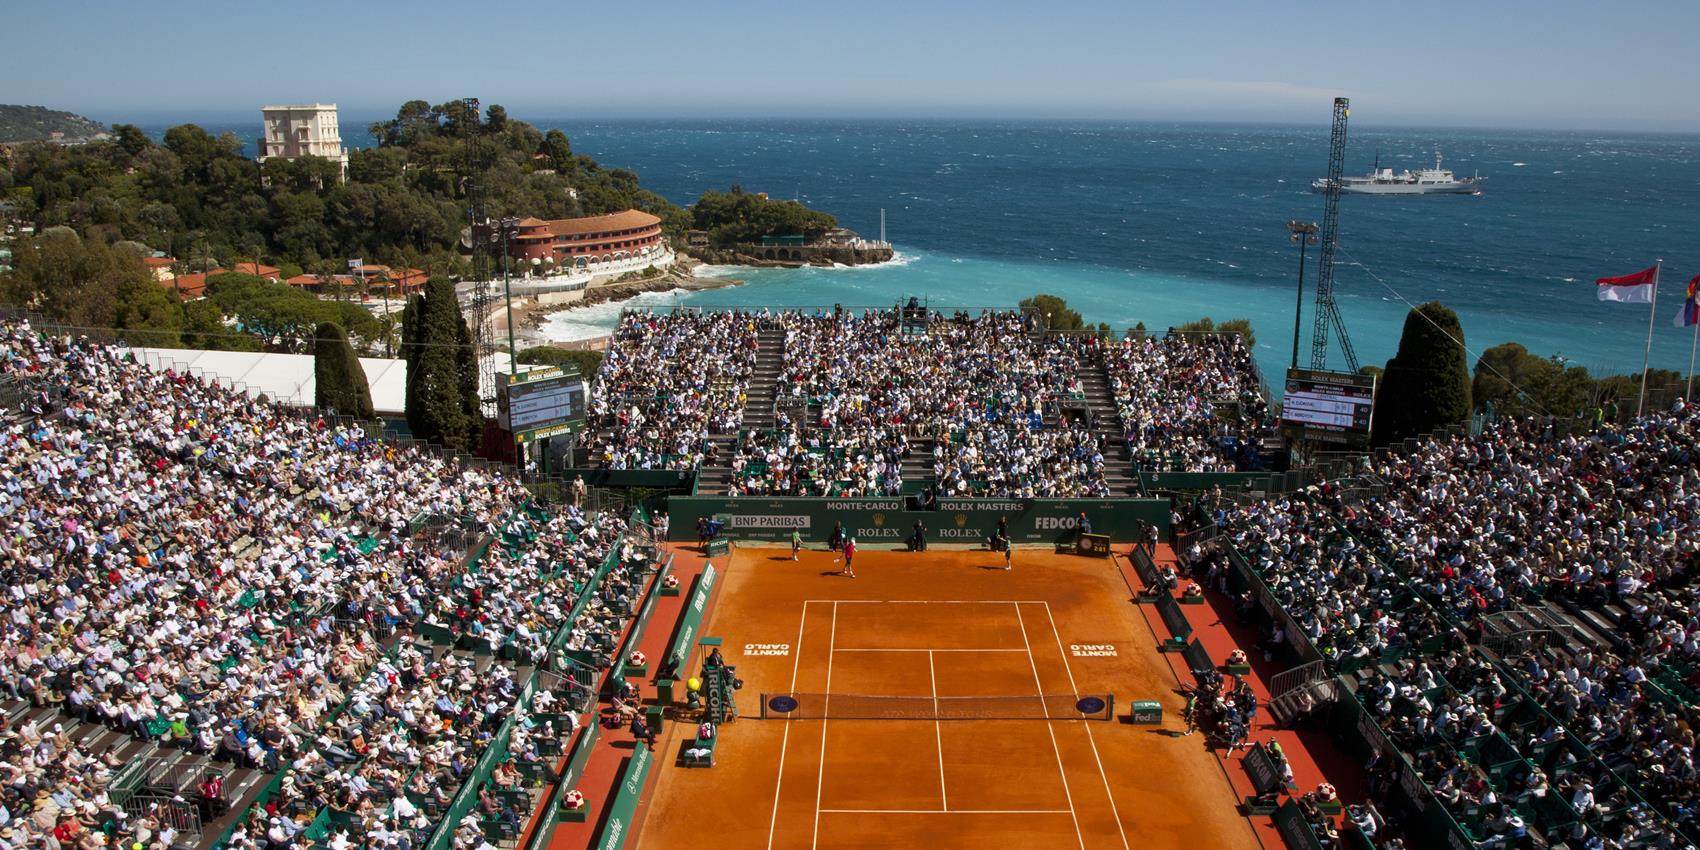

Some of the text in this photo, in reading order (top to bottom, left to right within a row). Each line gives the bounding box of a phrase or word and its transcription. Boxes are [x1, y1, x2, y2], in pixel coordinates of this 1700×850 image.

[826, 502, 899, 510] MONTE-CARLO
[977, 503, 1024, 511] MASTERS
[735, 517, 805, 526] BNP PARIBAS
[1035, 517, 1080, 529] FEDCO
[857, 529, 900, 537] ROLEX
[940, 529, 981, 537] ROLEX
[710, 539, 728, 548] RICOH
[709, 675, 720, 717] RICOH
